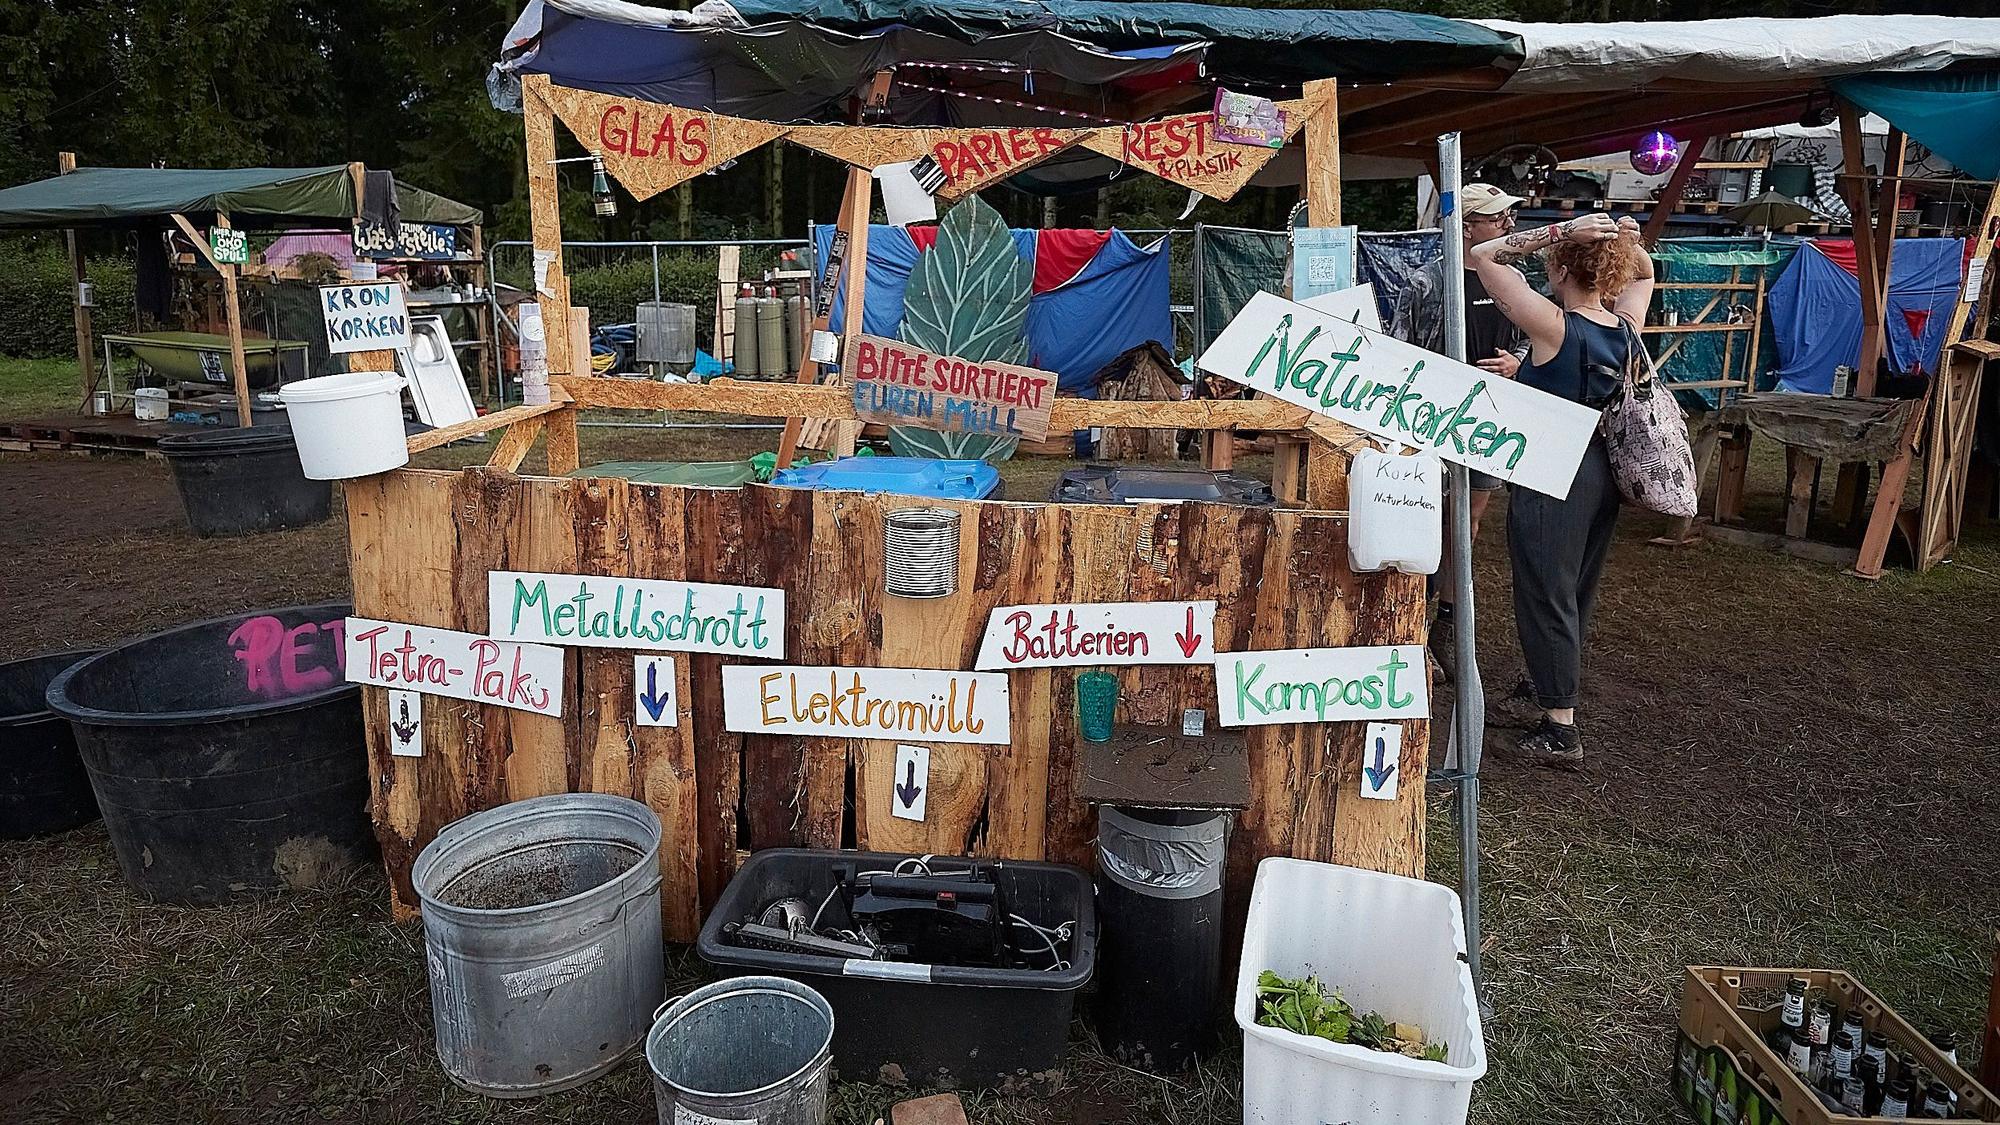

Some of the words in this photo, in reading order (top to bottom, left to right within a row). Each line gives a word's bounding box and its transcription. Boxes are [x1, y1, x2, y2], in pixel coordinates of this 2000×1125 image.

[600, 105, 708, 166] GLAS
[933, 128, 1065, 187] PAPIER
[1122, 114, 1215, 162] REST
[1175, 151, 1243, 179] PLASTIK
[217, 236, 243, 250] ÖKO
[353, 222, 446, 256] Wassrstelle
[400, 222, 424, 233] TRINK
[326, 286, 390, 312] KRON
[328, 315, 405, 343] KORKEN
[854, 380, 934, 418] EUREN
[856, 342, 928, 387] BITTE
[932, 358, 1048, 409] SORTIERT
[1245, 313, 1527, 470] Naturkorken
[1376, 458, 1425, 484] Kork
[1373, 492, 1436, 512] Naturkorken
[509, 578, 770, 650] Metallschrott
[1004, 609, 1148, 662] Batterien
[227, 615, 345, 693] PET
[760, 670, 984, 734] Elektromüll
[1235, 648, 1415, 721] Kompost
